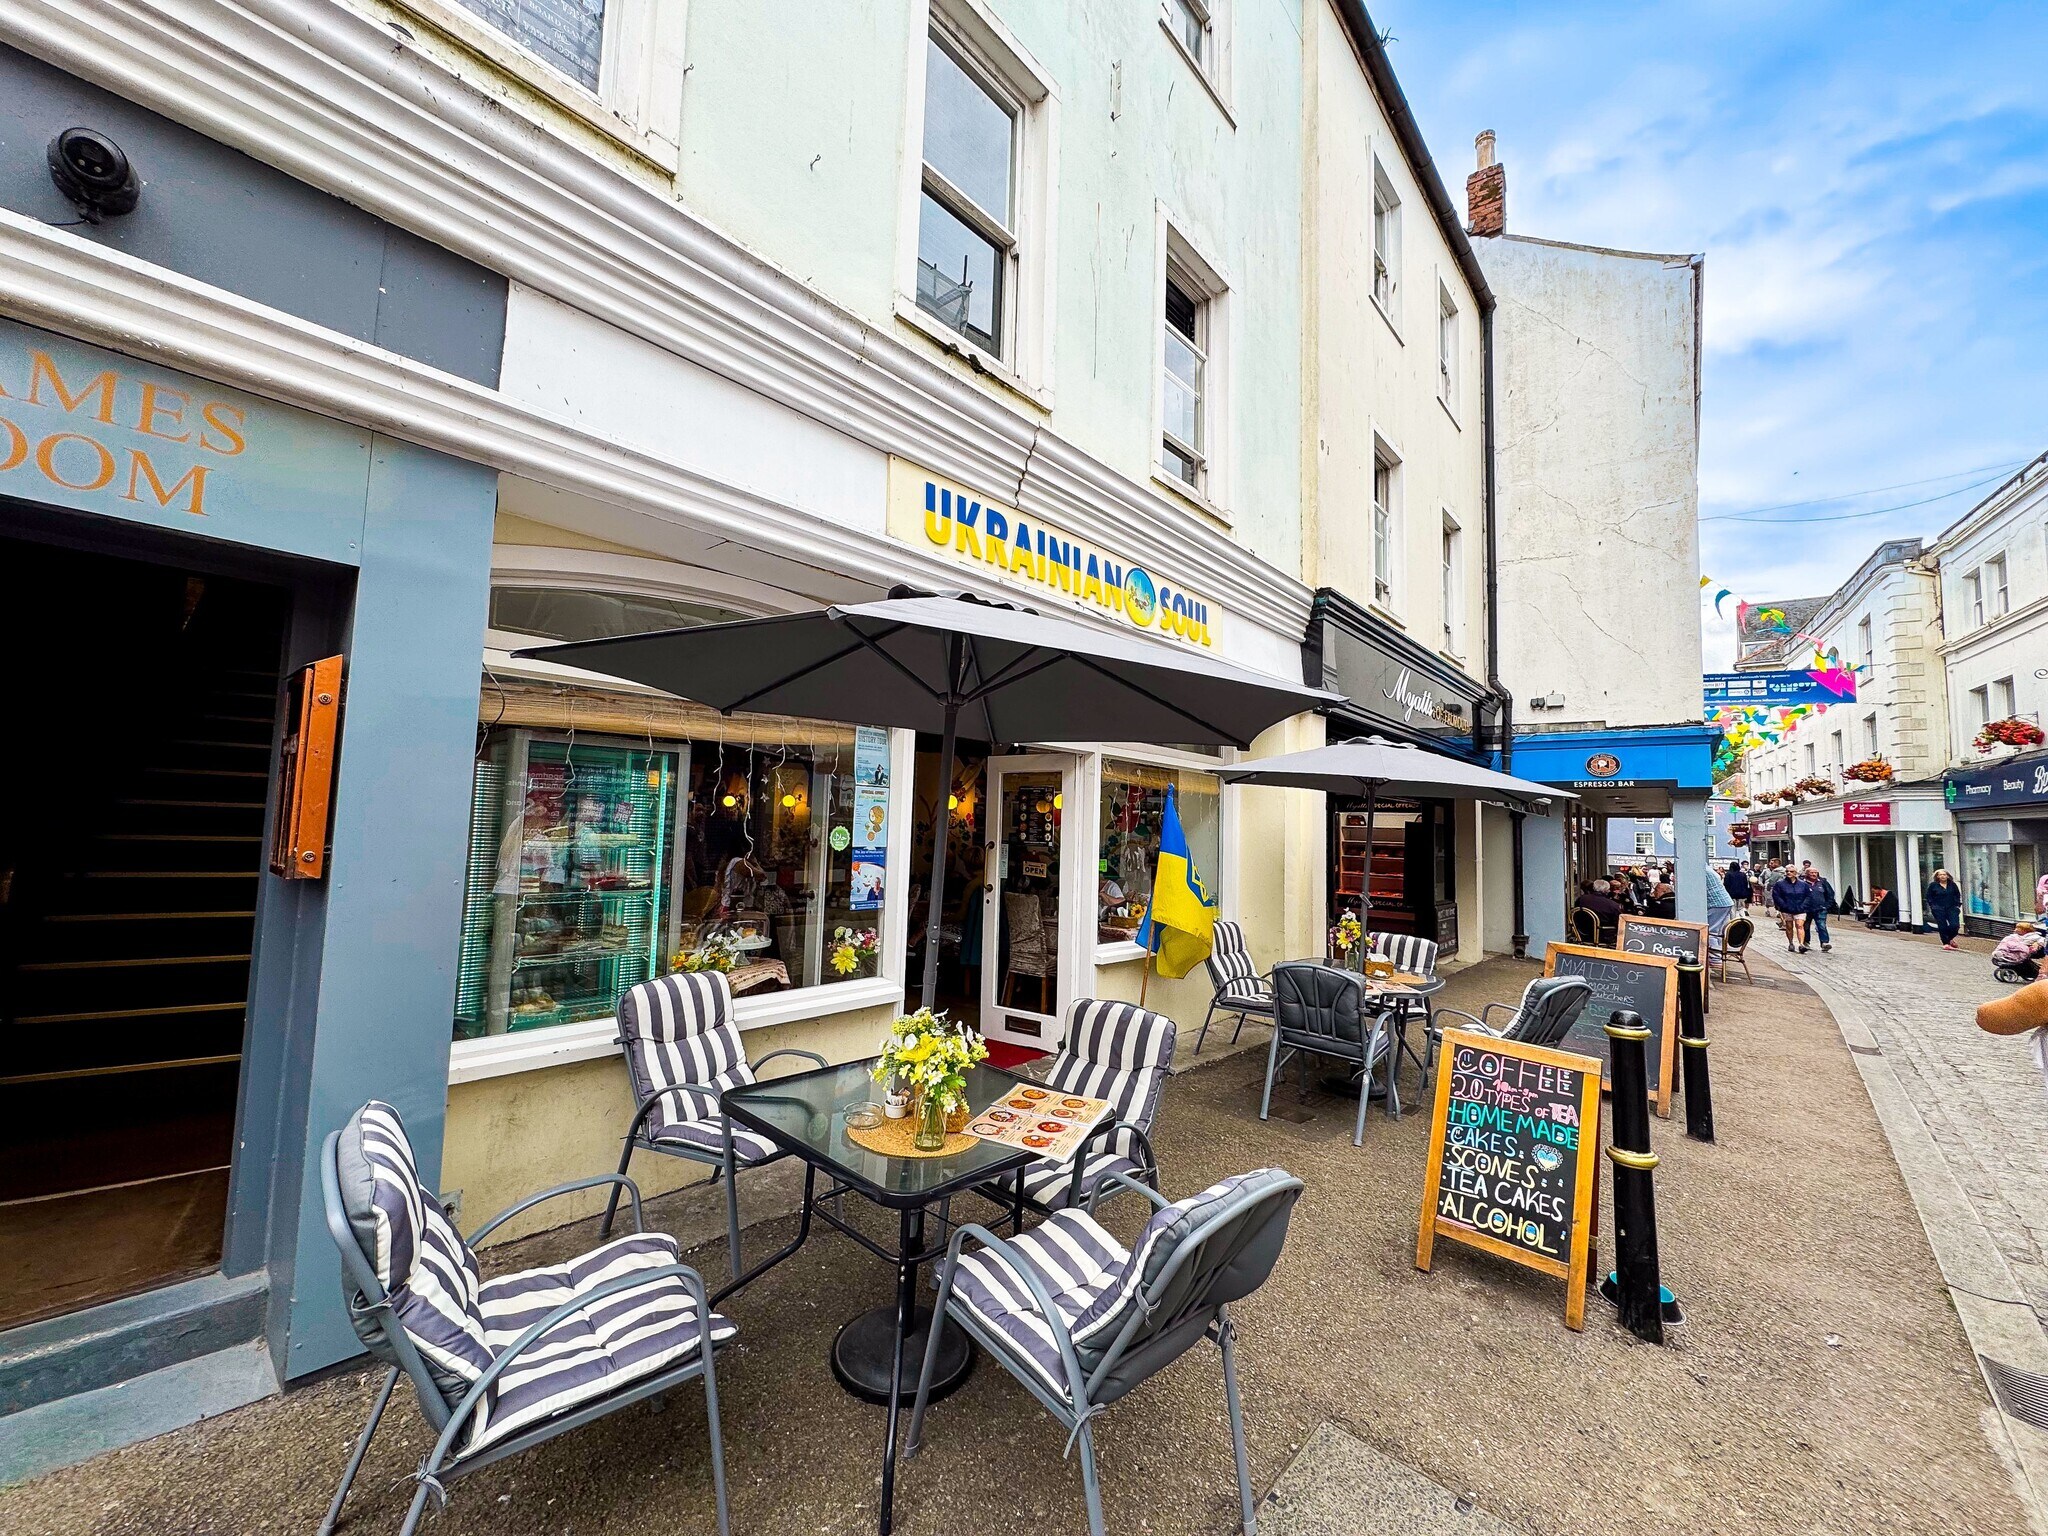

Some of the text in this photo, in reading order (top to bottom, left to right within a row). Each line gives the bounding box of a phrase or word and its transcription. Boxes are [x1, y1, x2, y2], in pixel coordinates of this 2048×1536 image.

[0, 347, 245, 457] MES
[924, 481, 1212, 646] UKRAINIAN SOUL
[1382, 667, 1433, 722] Myatts
[1769, 681, 1818, 689] FALMOUTH
[1965, 784, 1992, 796] Pharmacy
[2003, 779, 2025, 791] Beauty
[1024, 866, 1045, 875] OPEN
[1626, 970, 1646, 983] OF
[1457, 1049, 1575, 1097] COFFEE
[1453, 1074, 1579, 1127] 20 TYPES OF TEA
[1450, 1125, 1518, 1157] CAKES
[1449, 1144, 1540, 1189] SCONES
[1447, 1165, 1566, 1223] TEA CAKES
[1442, 1192, 1559, 1254] ALCOHOL
